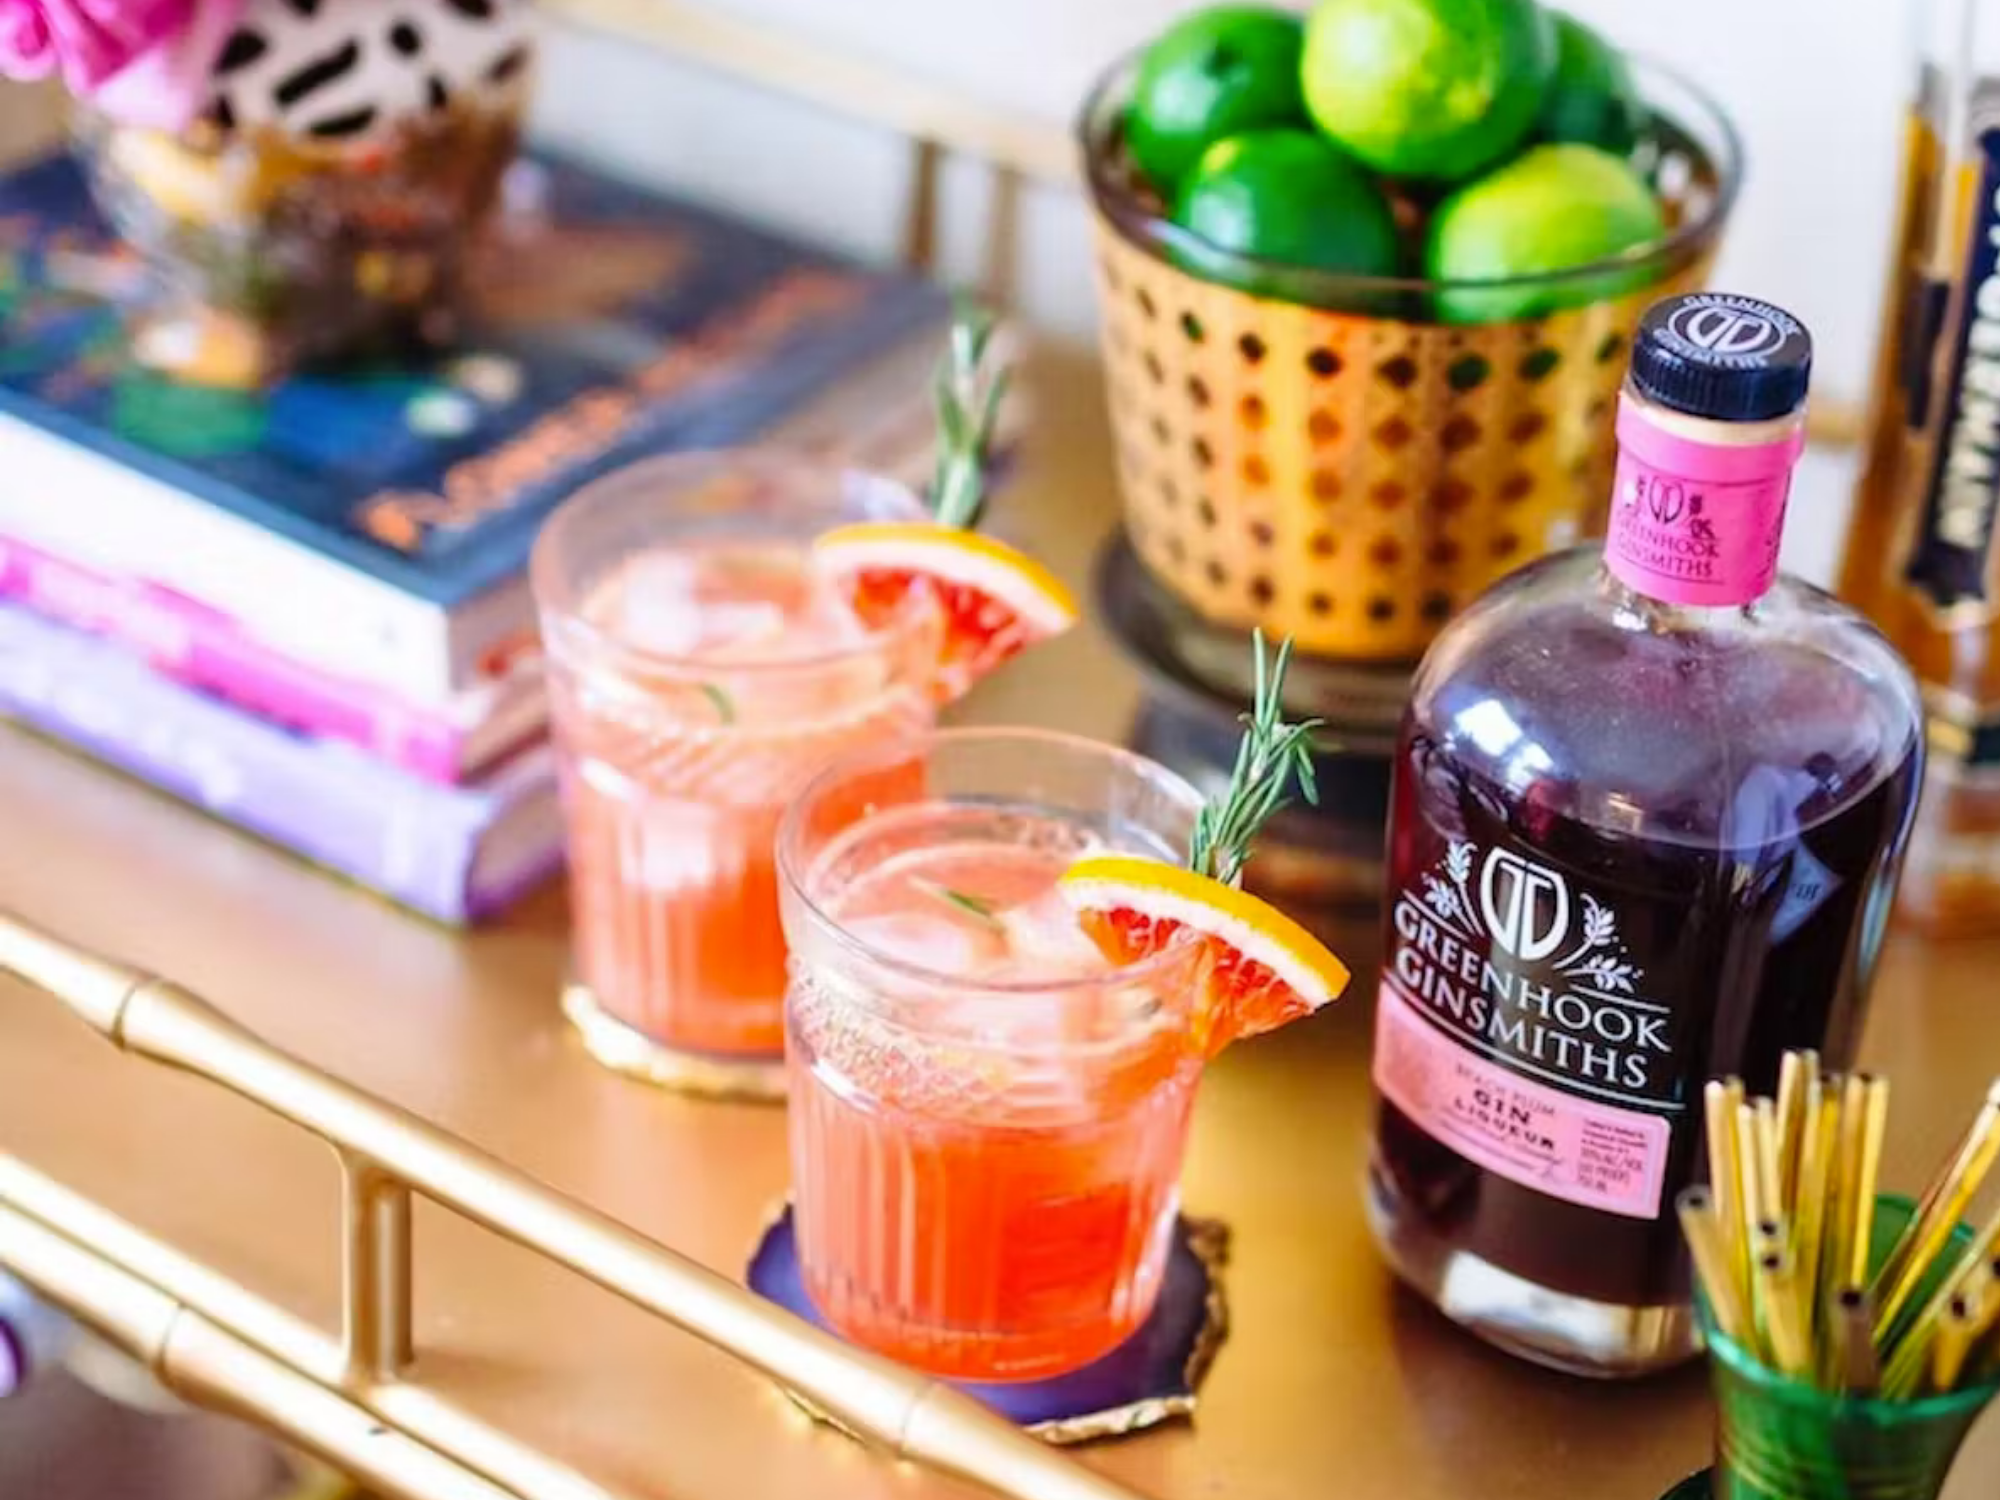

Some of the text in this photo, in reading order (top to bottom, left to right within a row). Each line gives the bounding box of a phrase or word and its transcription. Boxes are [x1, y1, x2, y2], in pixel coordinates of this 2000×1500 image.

[1394, 901, 1672, 1053] GREENHOOK
[1396, 947, 1647, 1089] GINSMITHS
[1454, 1096, 1555, 1151] LIQUEUR
[1474, 1089, 1531, 1125] GIN
